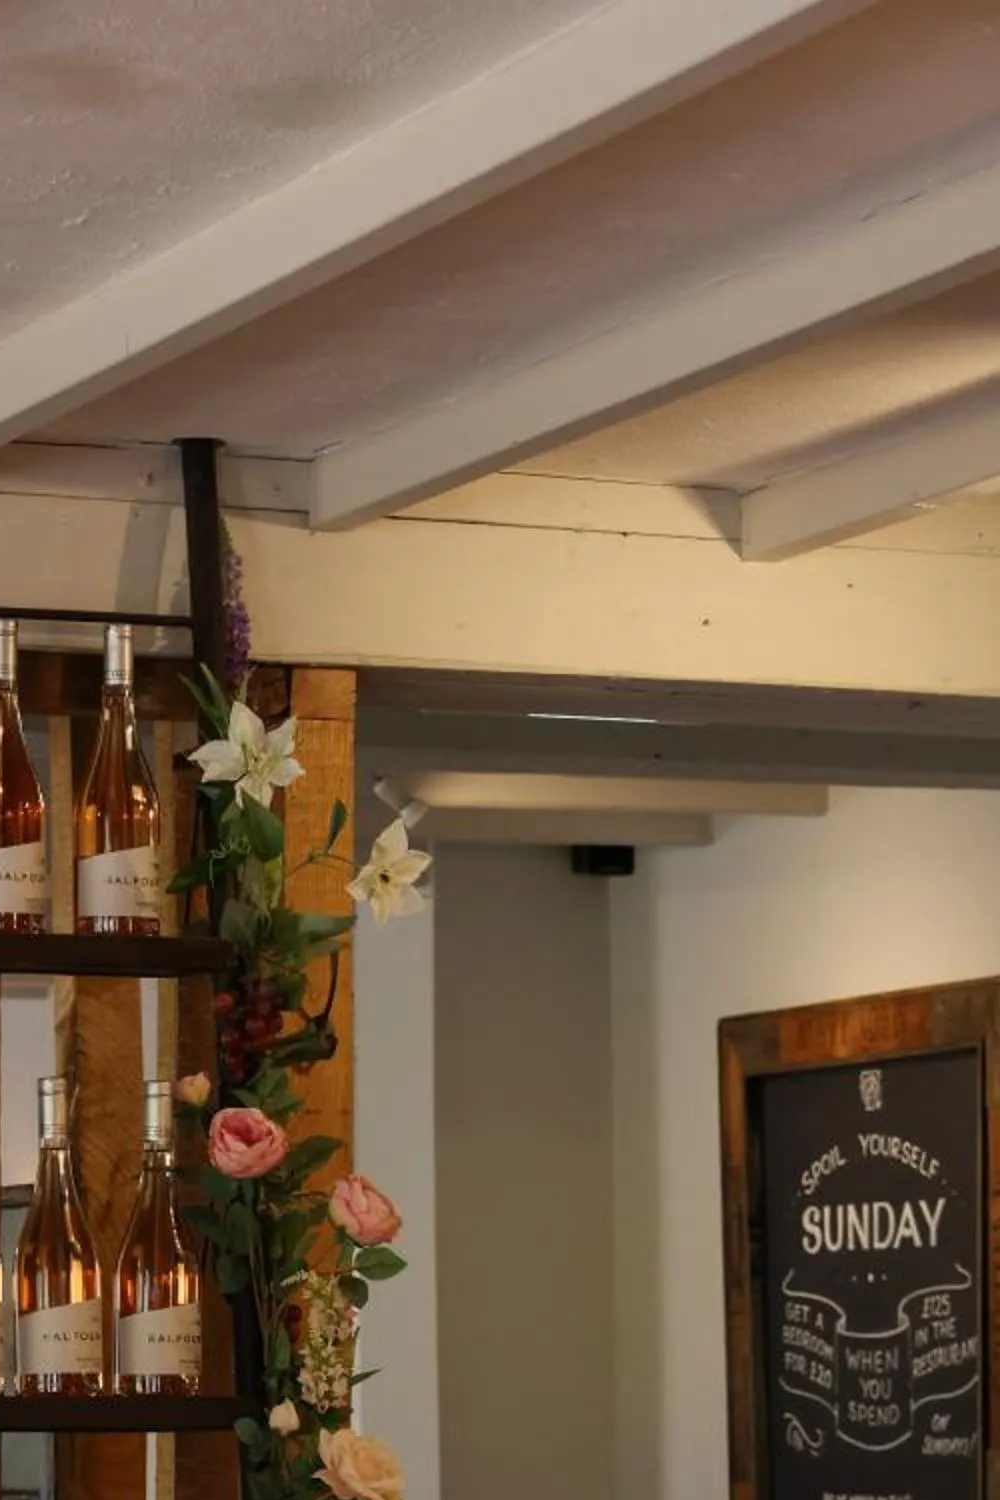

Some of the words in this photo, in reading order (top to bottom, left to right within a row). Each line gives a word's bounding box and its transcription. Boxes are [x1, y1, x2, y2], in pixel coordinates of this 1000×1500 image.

[802, 1145, 847, 1195] SPOIL
[857, 1133, 941, 1179] YOURSELF
[802, 1198, 947, 1255] SUNDAY
[784, 1301, 812, 1323] GET
[814, 1312, 825, 1331] A
[147, 1333, 201, 1345] BALFOU
[782, 1325, 834, 1361] BEDROOM
[914, 1327, 929, 1347] IN
[931, 1317, 957, 1340] THE
[785, 1351, 808, 1376] FOR
[845, 1346, 900, 1374] WHEN
[859, 1377, 892, 1401] YOU
[847, 1401, 901, 1428] SPEND
